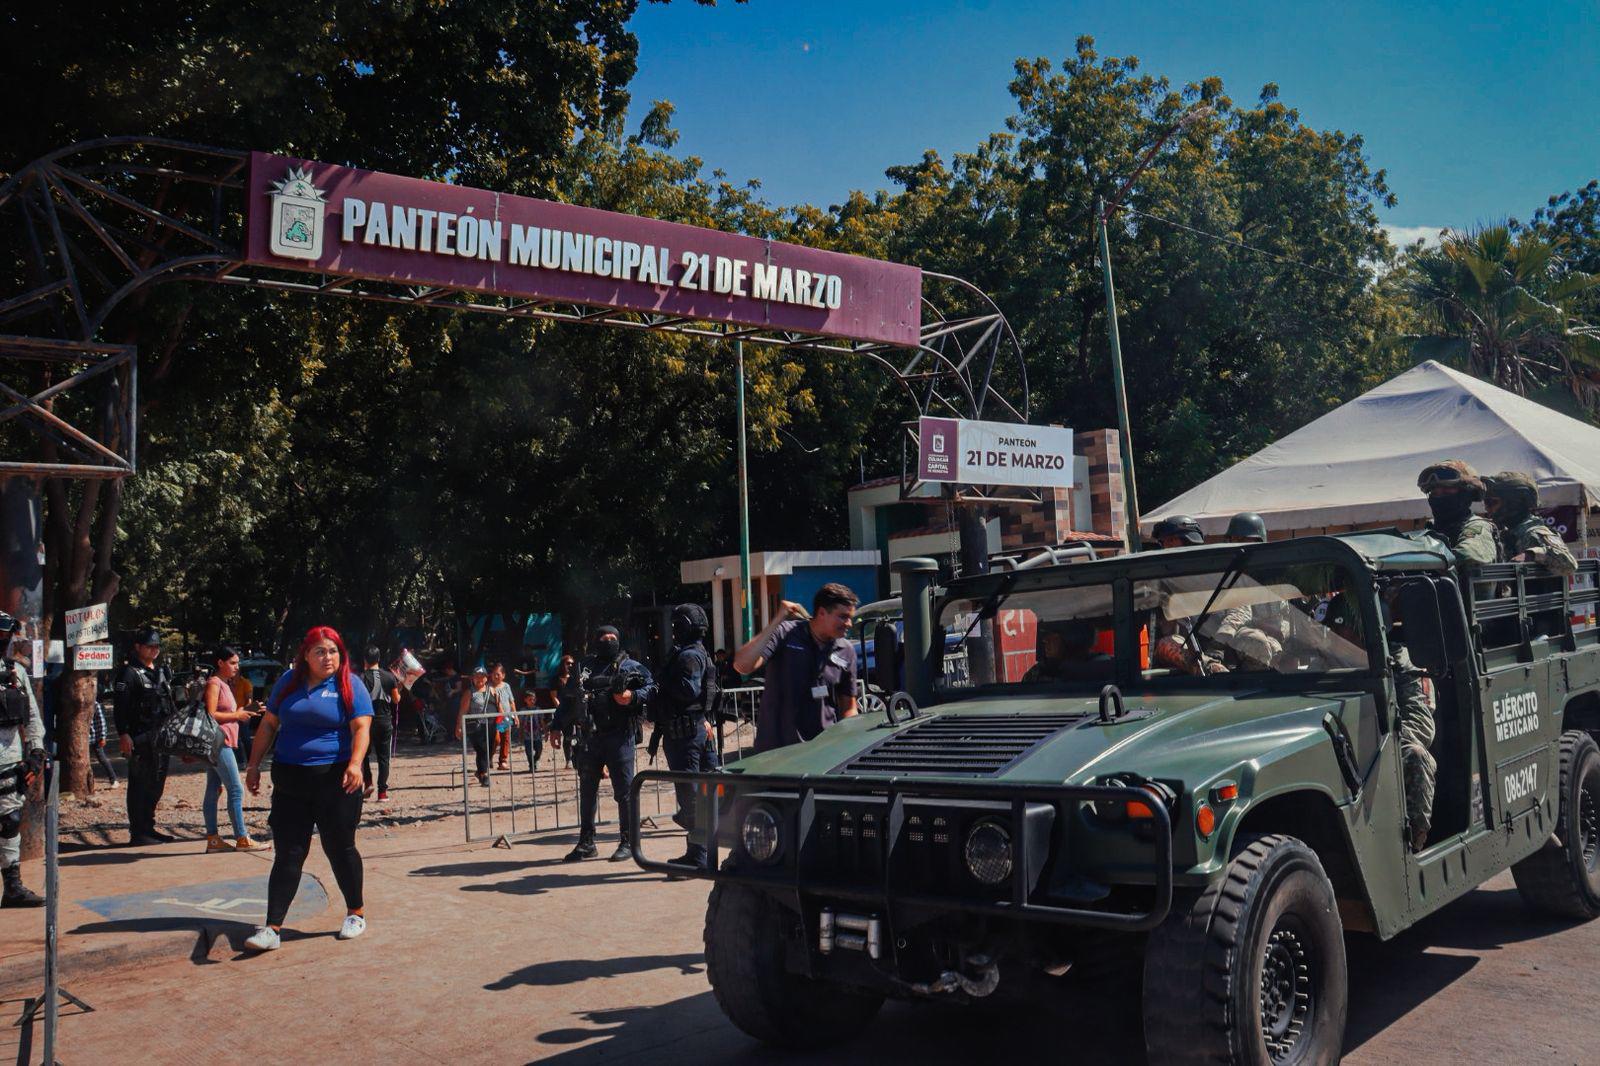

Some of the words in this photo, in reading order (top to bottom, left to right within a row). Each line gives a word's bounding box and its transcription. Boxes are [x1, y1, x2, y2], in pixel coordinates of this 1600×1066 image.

[341, 197, 502, 262] PANTEÓN
[508, 223, 674, 287] MUNICIPAL
[678, 251, 710, 291] 21
[713, 255, 748, 297] DE
[752, 262, 842, 310] MARZO
[967, 450, 982, 466] 21
[986, 451, 1007, 467] DE
[1012, 452, 1065, 470] MARZO
[1493, 691, 1538, 724] EJÉRCITO
[1496, 713, 1539, 742] MEXICANO
[1504, 762, 1538, 804] 0862147
